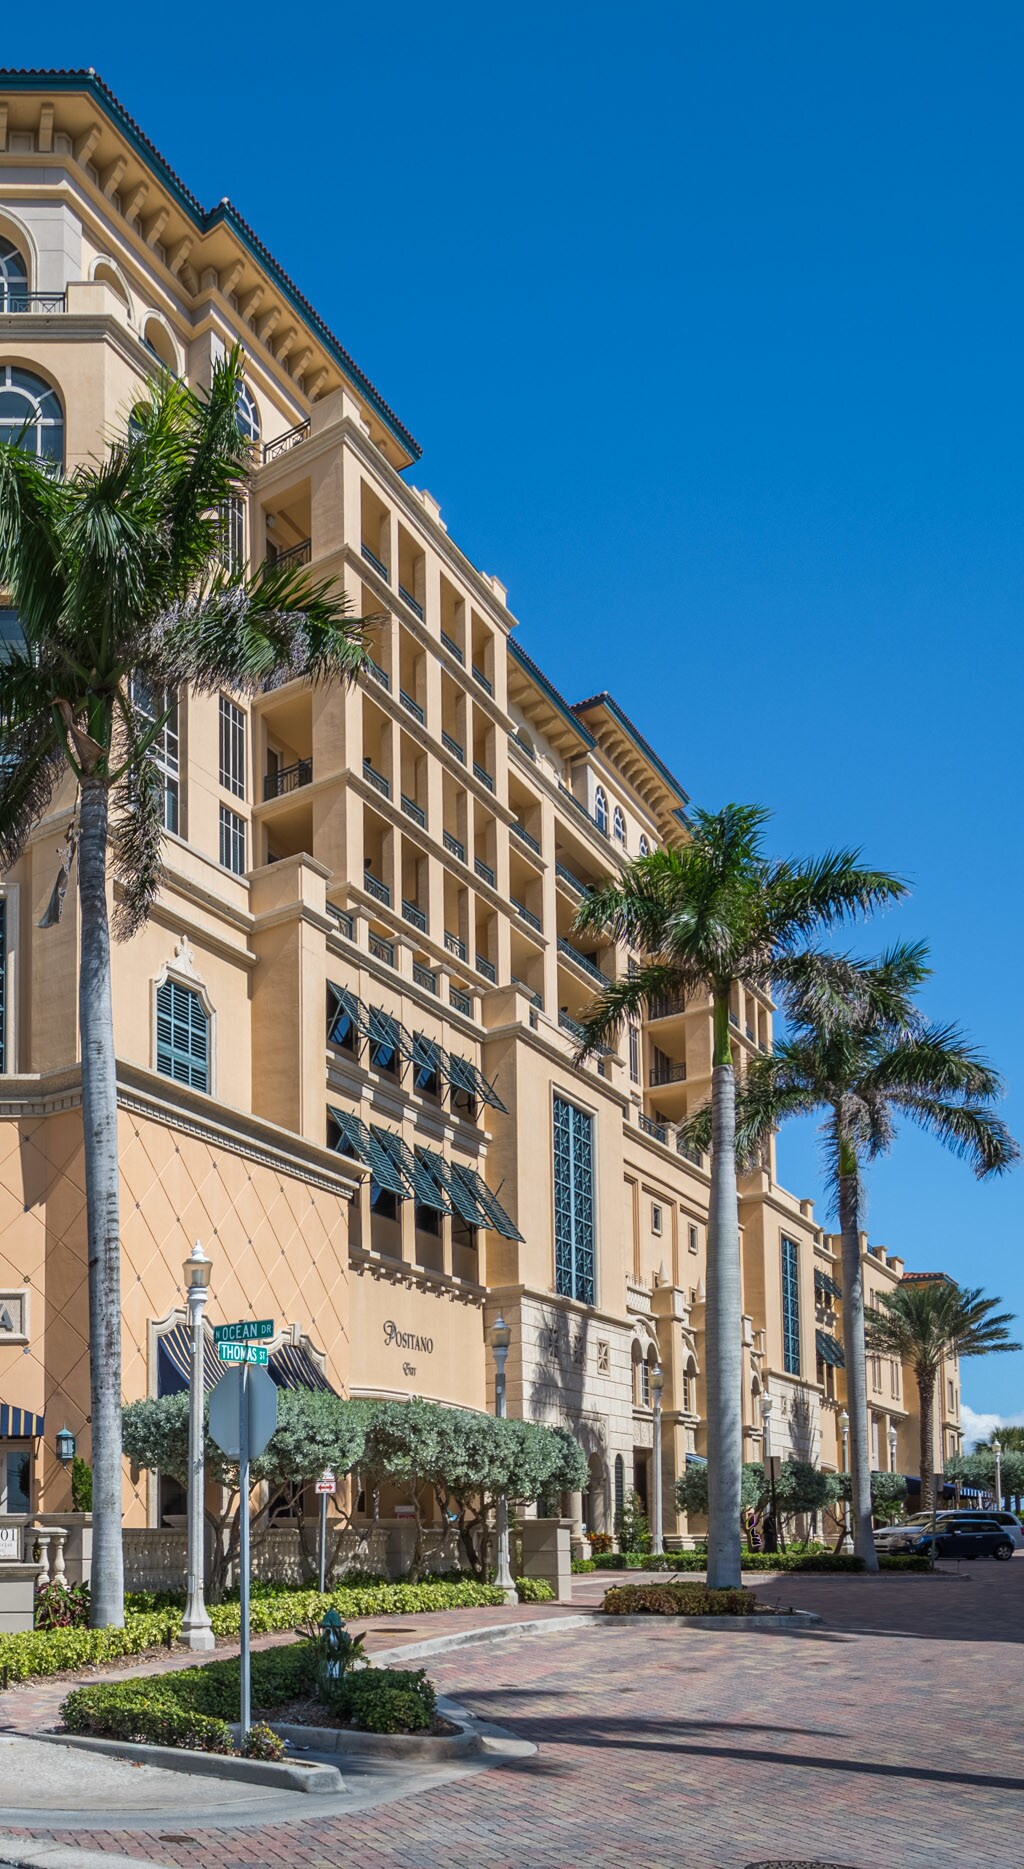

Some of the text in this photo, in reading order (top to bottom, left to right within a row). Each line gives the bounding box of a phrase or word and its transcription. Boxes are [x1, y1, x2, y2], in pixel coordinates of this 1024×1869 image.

[222, 1324, 257, 1340] OCEAN
[261, 1324, 271, 1333] DR
[383, 1320, 433, 1354] POSITANO
[259, 1351, 265, 1360] ST
